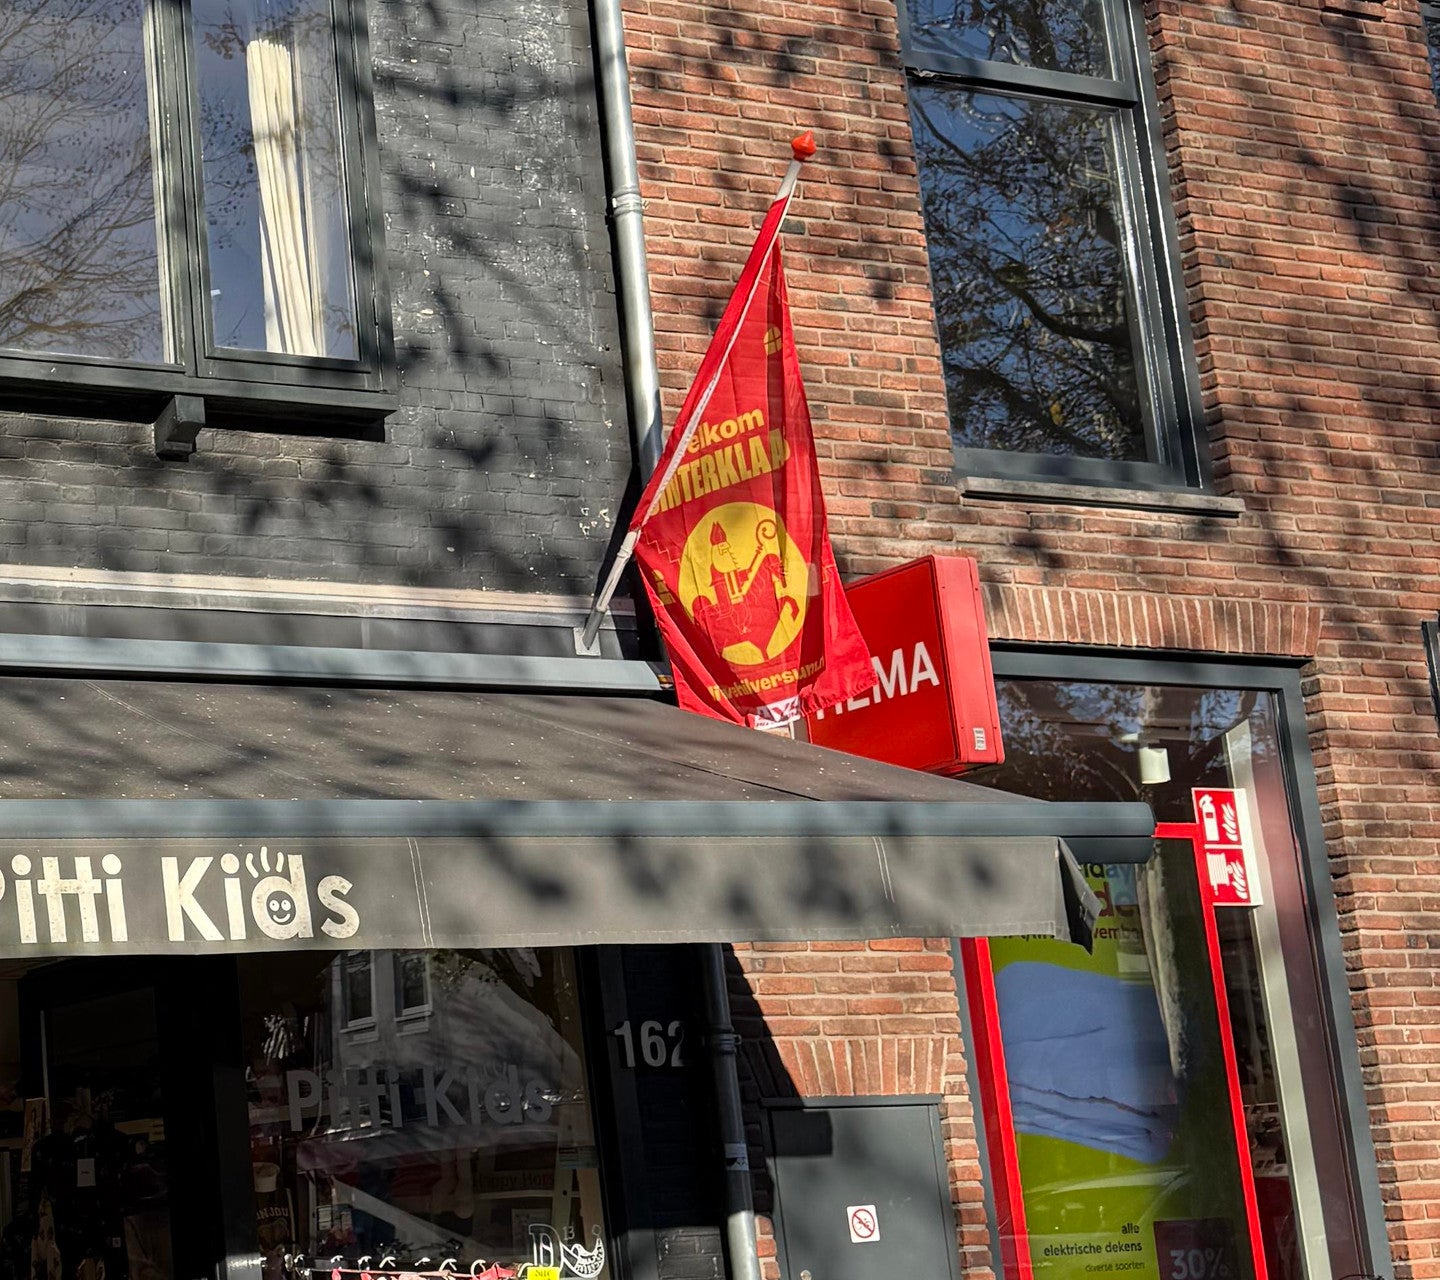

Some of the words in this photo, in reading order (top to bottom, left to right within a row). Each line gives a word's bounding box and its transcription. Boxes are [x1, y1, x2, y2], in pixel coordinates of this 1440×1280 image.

[686, 408, 765, 454] elkom
[816, 641, 940, 720] MA
[160, 846, 361, 942] Kids
[614, 1020, 692, 1067] 162
[286, 1067, 403, 1131] Pitti
[423, 1062, 553, 1127] Kids
[1044, 1243, 1102, 1257] elektrische
[1105, 1240, 1143, 1253] dekens
[1121, 1222, 1140, 1235] alle
[1168, 1247, 1230, 1280] 30%
